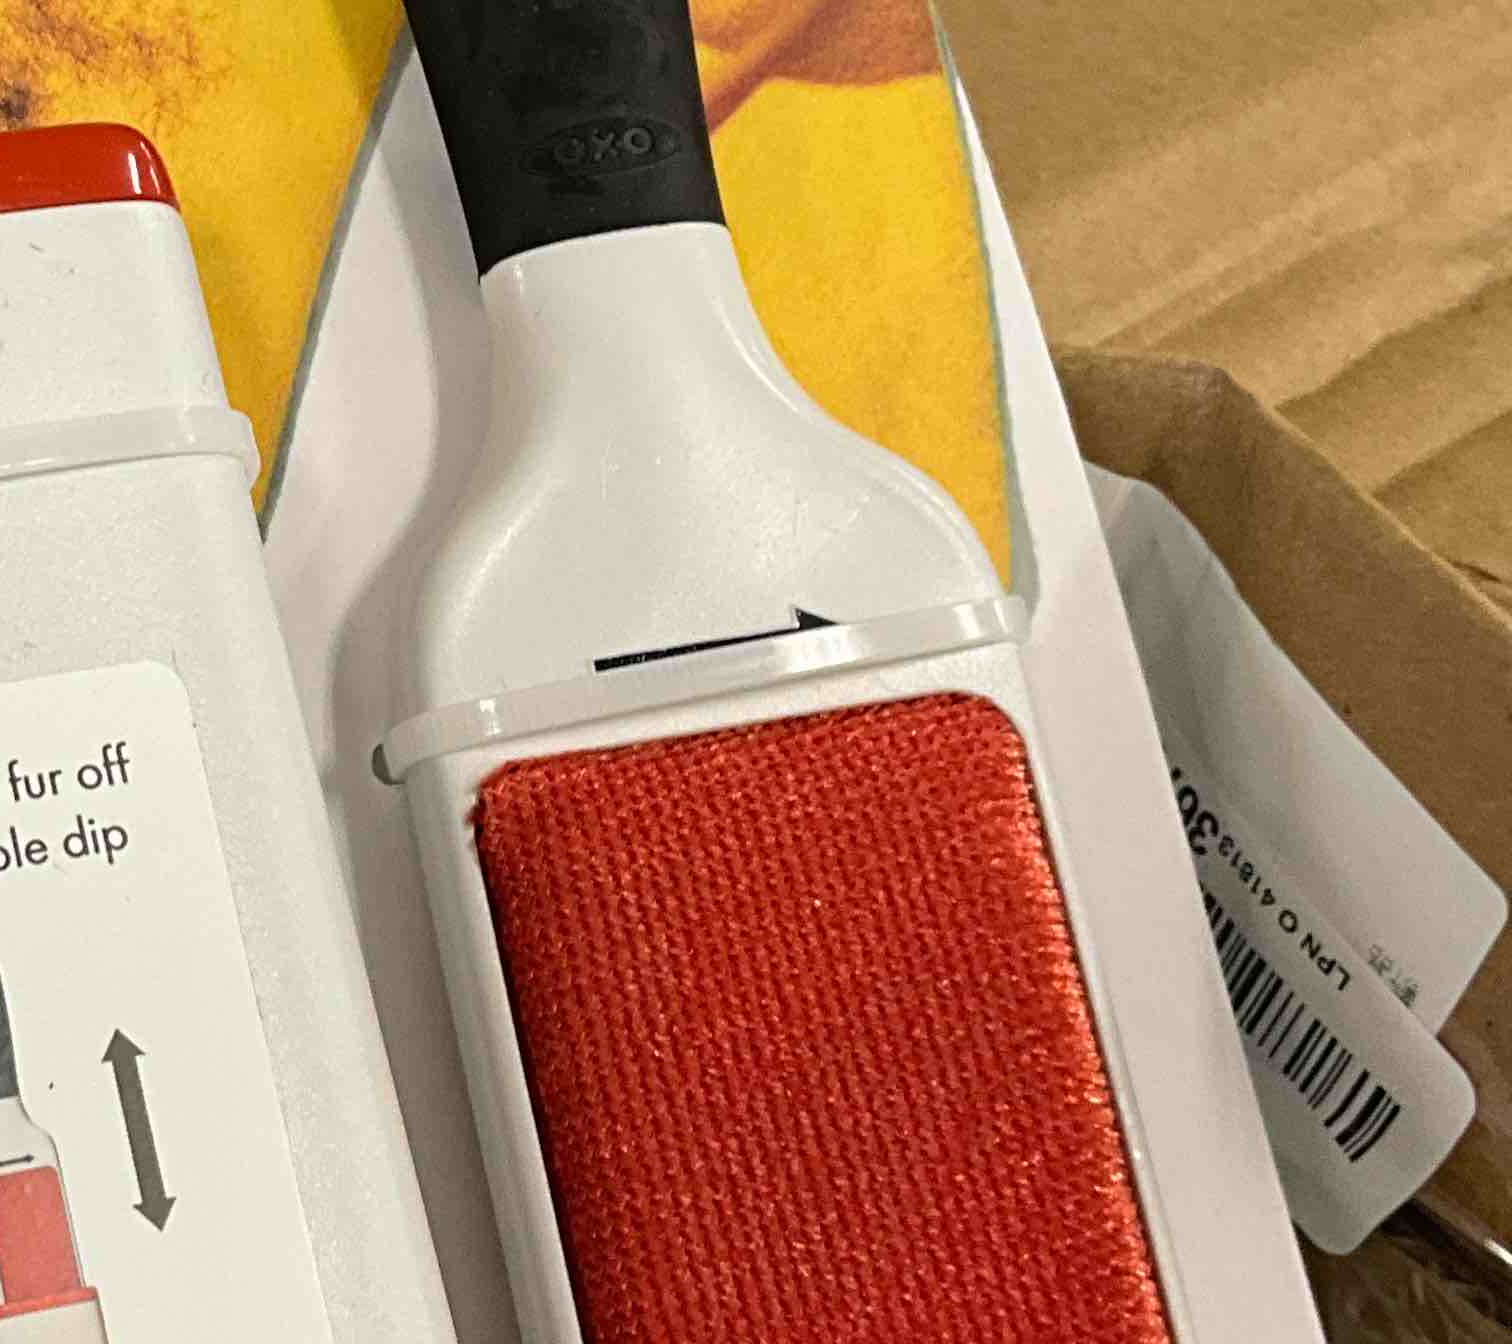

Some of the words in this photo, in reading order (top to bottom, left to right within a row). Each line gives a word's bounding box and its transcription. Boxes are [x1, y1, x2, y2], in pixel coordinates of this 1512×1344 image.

[8, 759, 63, 803] fur
[77, 741, 132, 791] off
[62, 814, 130, 865] dip
[1300, 932, 1351, 991] LPN
